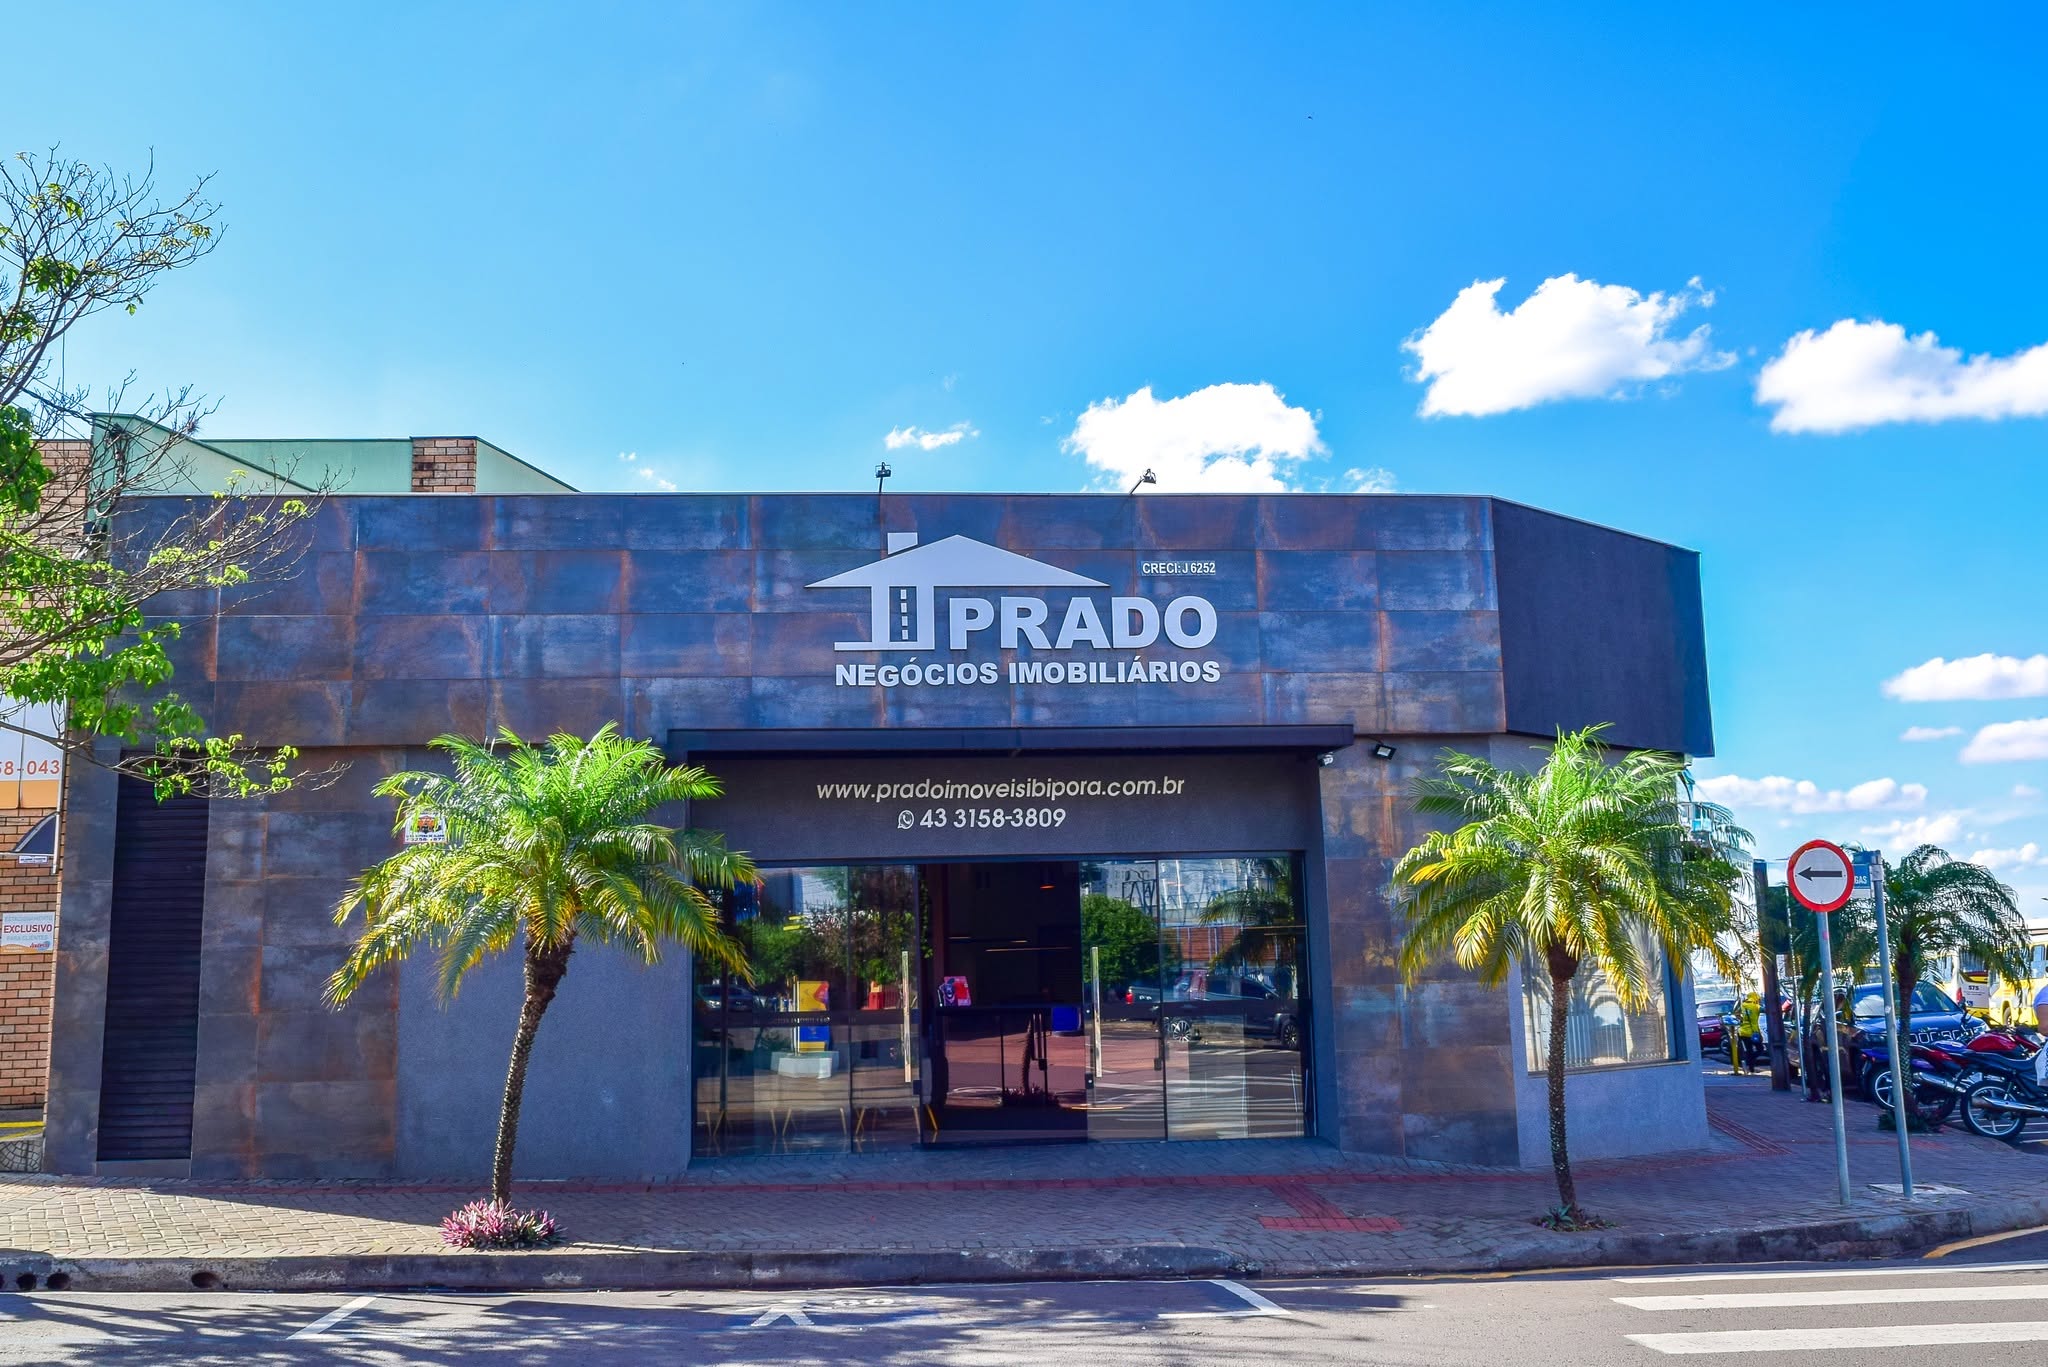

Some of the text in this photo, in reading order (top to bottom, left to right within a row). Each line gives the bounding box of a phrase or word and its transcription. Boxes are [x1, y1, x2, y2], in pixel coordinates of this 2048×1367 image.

[1190, 562, 1216, 573] 6252
[949, 595, 1218, 650] PRADO
[835, 655, 1221, 687] NEGÓCIOS IMOBILIÁRIOS
[0, 759, 60, 776] 8-043
[816, 776, 1185, 803] www.pradoimoveisibipora.com.br
[919, 807, 1067, 828] 43 3158-3809
[1854, 875, 1868, 885] GAS
[3, 924, 53, 934] EXCLUSIVO
